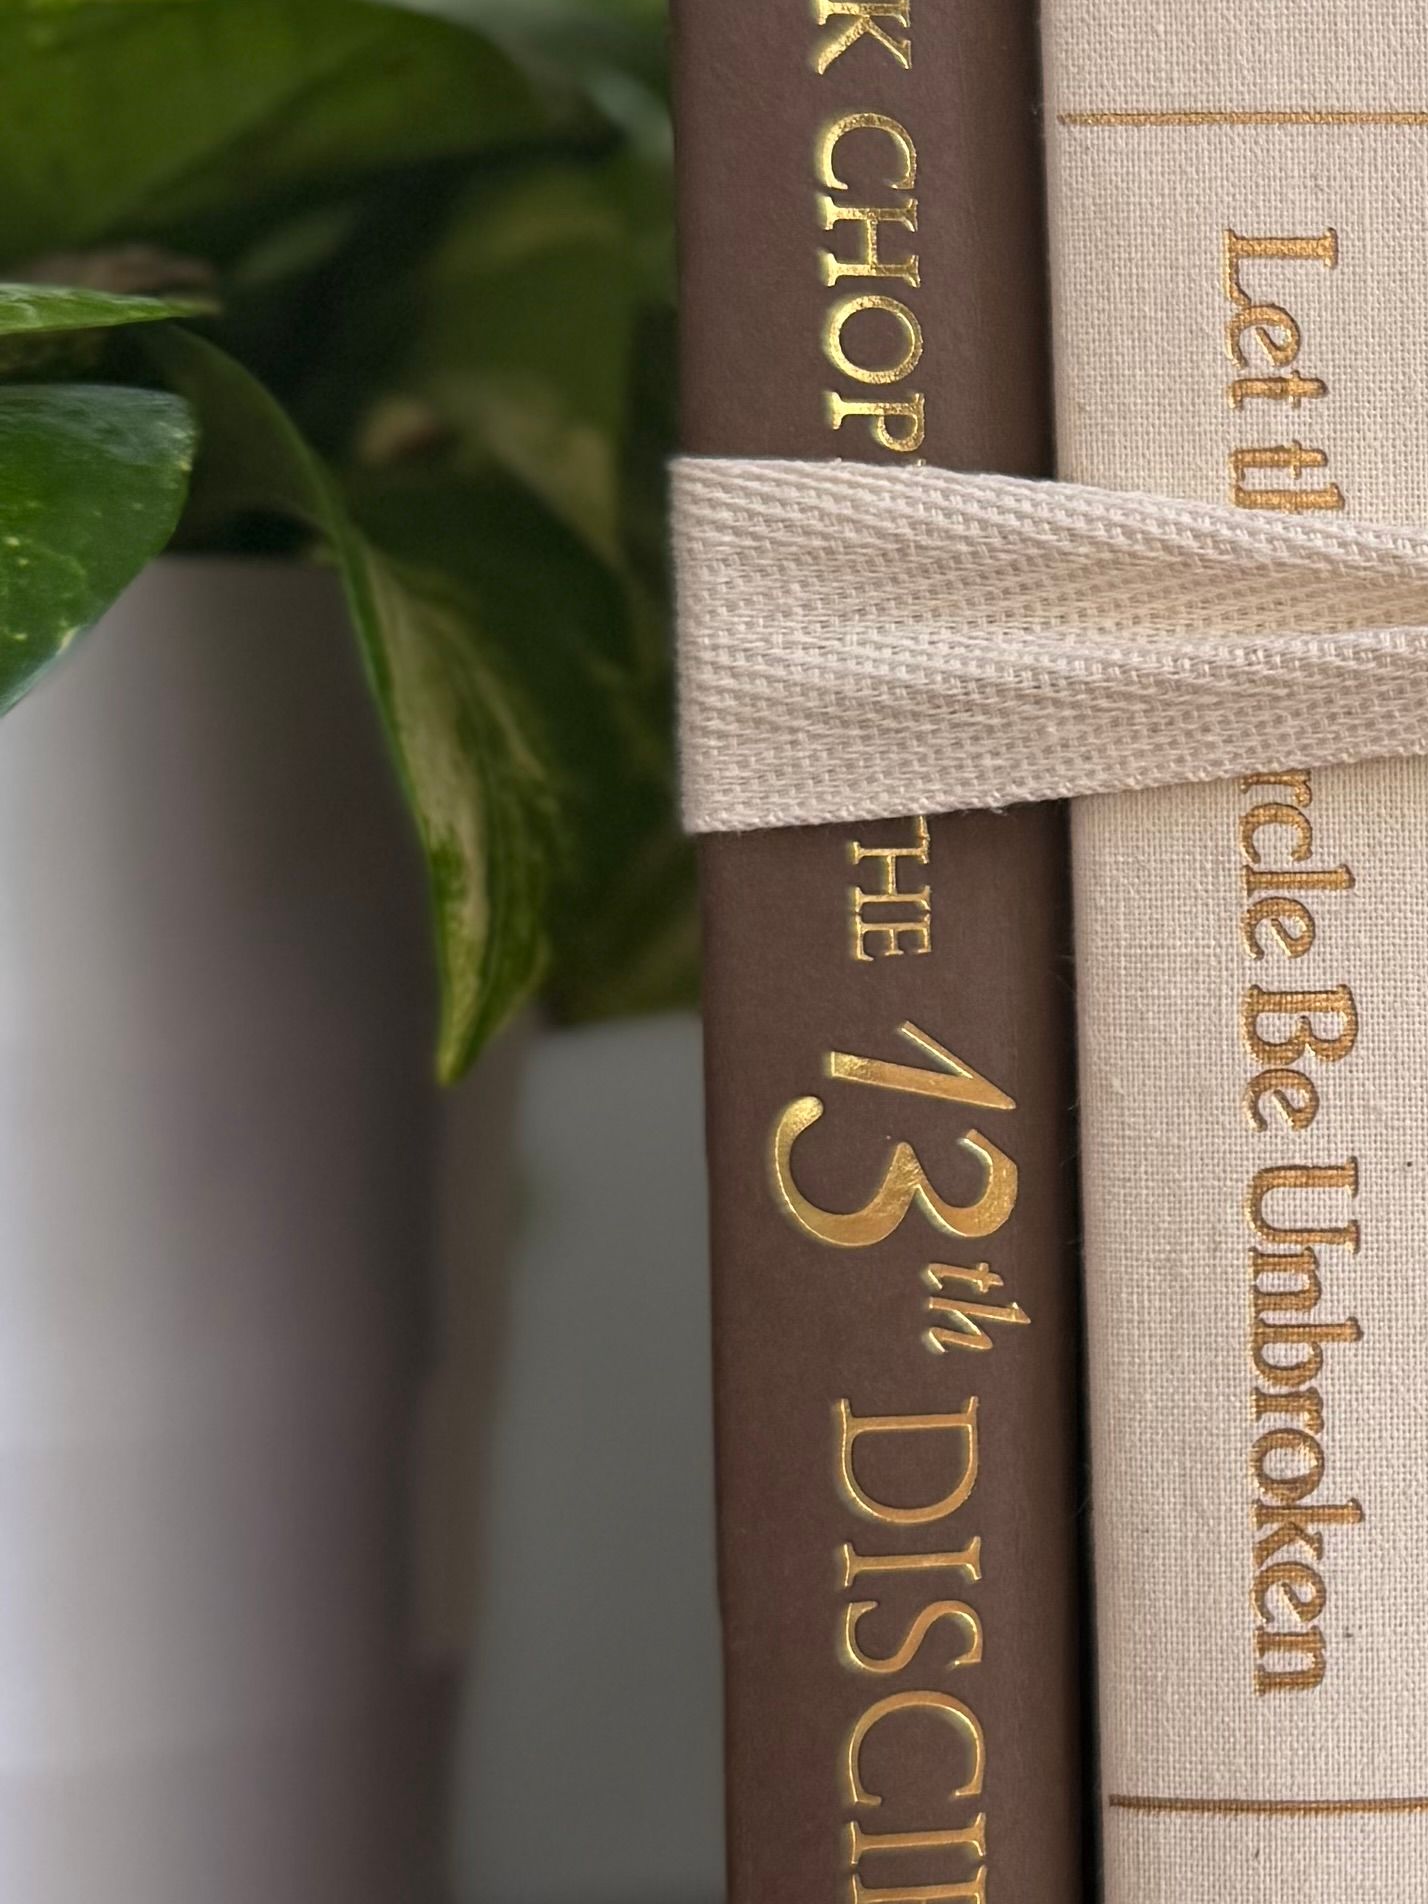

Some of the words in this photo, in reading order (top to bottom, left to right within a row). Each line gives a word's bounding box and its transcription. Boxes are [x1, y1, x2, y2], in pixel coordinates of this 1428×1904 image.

[815, 111, 929, 467] CHOP
[1222, 226, 1340, 410] Let
[1238, 768, 1357, 962] rcle
[775, 1020, 1031, 1355] 13th
[1240, 983, 1359, 1134] Be
[1245, 1155, 1366, 1698] Unbroken
